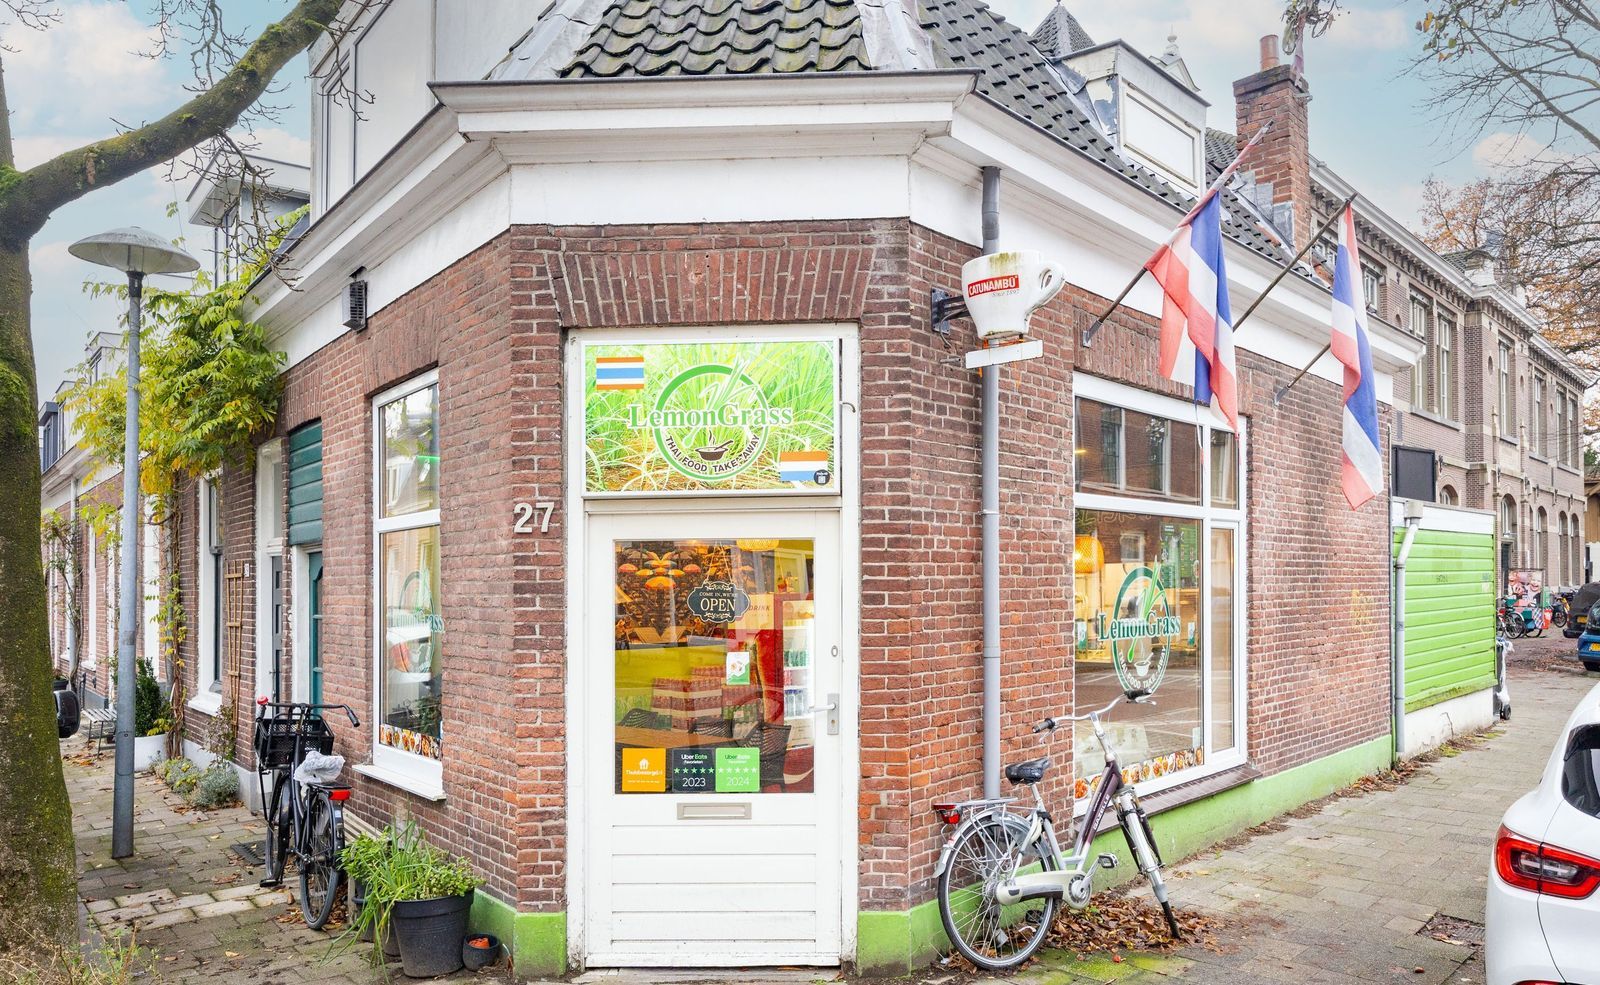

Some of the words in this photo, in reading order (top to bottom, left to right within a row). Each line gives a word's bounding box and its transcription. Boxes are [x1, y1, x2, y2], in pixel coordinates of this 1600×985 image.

[629, 403, 792, 428] LemonGrass
[666, 436, 682, 457] THAI
[682, 457, 708, 472] FOOD
[513, 501, 554, 533] 27
[700, 597, 735, 612] OPEN
[1098, 610, 1181, 641] LemonGrass
[1127, 672, 1141, 689] FOOD
[682, 777, 706, 787] 2023
[727, 777, 749, 787] 2024
